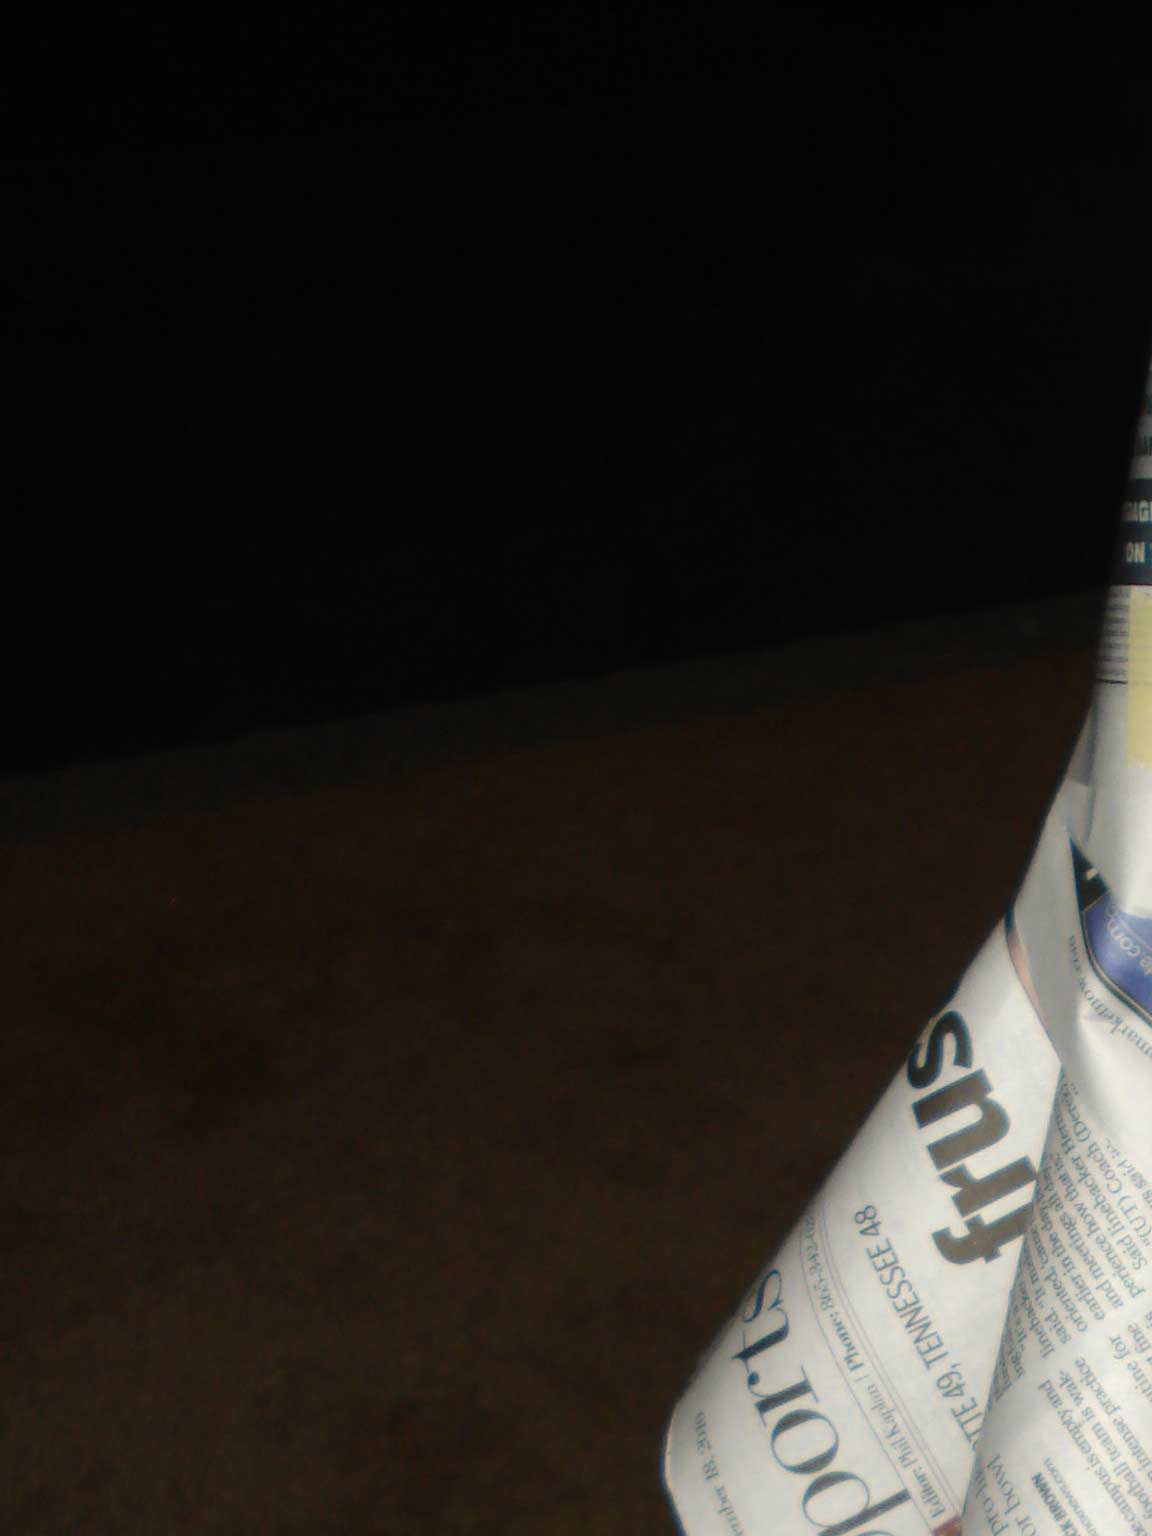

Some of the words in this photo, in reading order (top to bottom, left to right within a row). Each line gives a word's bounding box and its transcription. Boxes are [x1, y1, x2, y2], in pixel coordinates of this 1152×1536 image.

[1125, 542, 1145, 562] ON
[1068, 1151, 1127, 1236] linebacker
[1083, 1139, 1126, 1196] Coach
[1116, 1153, 1148, 1193] said
[848, 1201, 887, 1243] 48
[1072, 1197, 1102, 1236] how
[1055, 1208, 1108, 1282] meetings
[1091, 1228, 1145, 1301] perience
[1117, 1232, 1149, 1271] Said
[864, 1233, 952, 1371] TENNESSEE
[1069, 1271, 1108, 1323] earlier
[1096, 1276, 1124, 1311] and
[823, 1307, 868, 1373] Phone:
[1104, 1331, 1133, 1362] for
[929, 1360, 973, 1405] 49,
[1036, 1377, 1066, 1411] and
[1069, 1351, 1124, 1418] practice
[861, 1379, 905, 1441] Kaplan
[1053, 1402, 1098, 1457] empty
[1077, 1404, 1096, 1423] is
[889, 1434, 920, 1470] Phil
[1087, 1420, 1123, 1463] team
[907, 1462, 948, 1520] Editor:
[973, 1450, 1031, 1516] bowl
[1026, 1469, 1070, 1523] BROWN
[1091, 1462, 1143, 1527] campus
